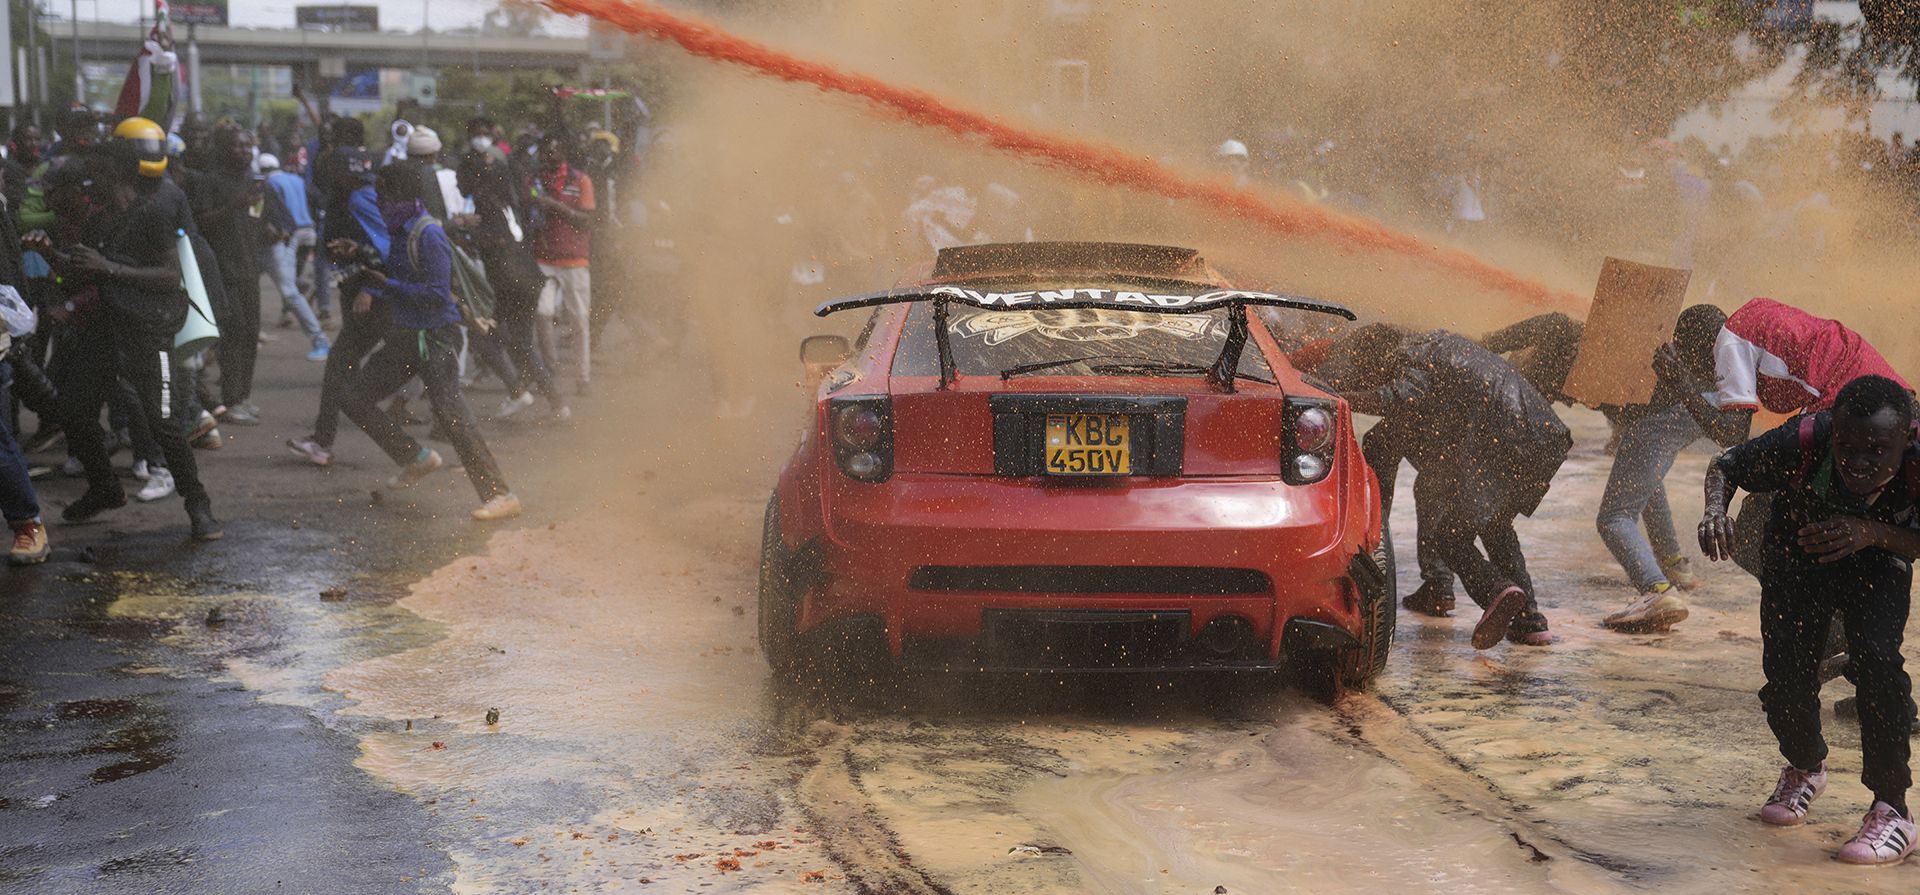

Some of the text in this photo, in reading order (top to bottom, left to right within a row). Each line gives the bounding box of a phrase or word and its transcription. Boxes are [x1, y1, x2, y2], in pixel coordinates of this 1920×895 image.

[931, 287, 1287, 305] AVENTADOR
[1066, 415, 1123, 445] KBC
[1050, 449, 1122, 472] 450V
